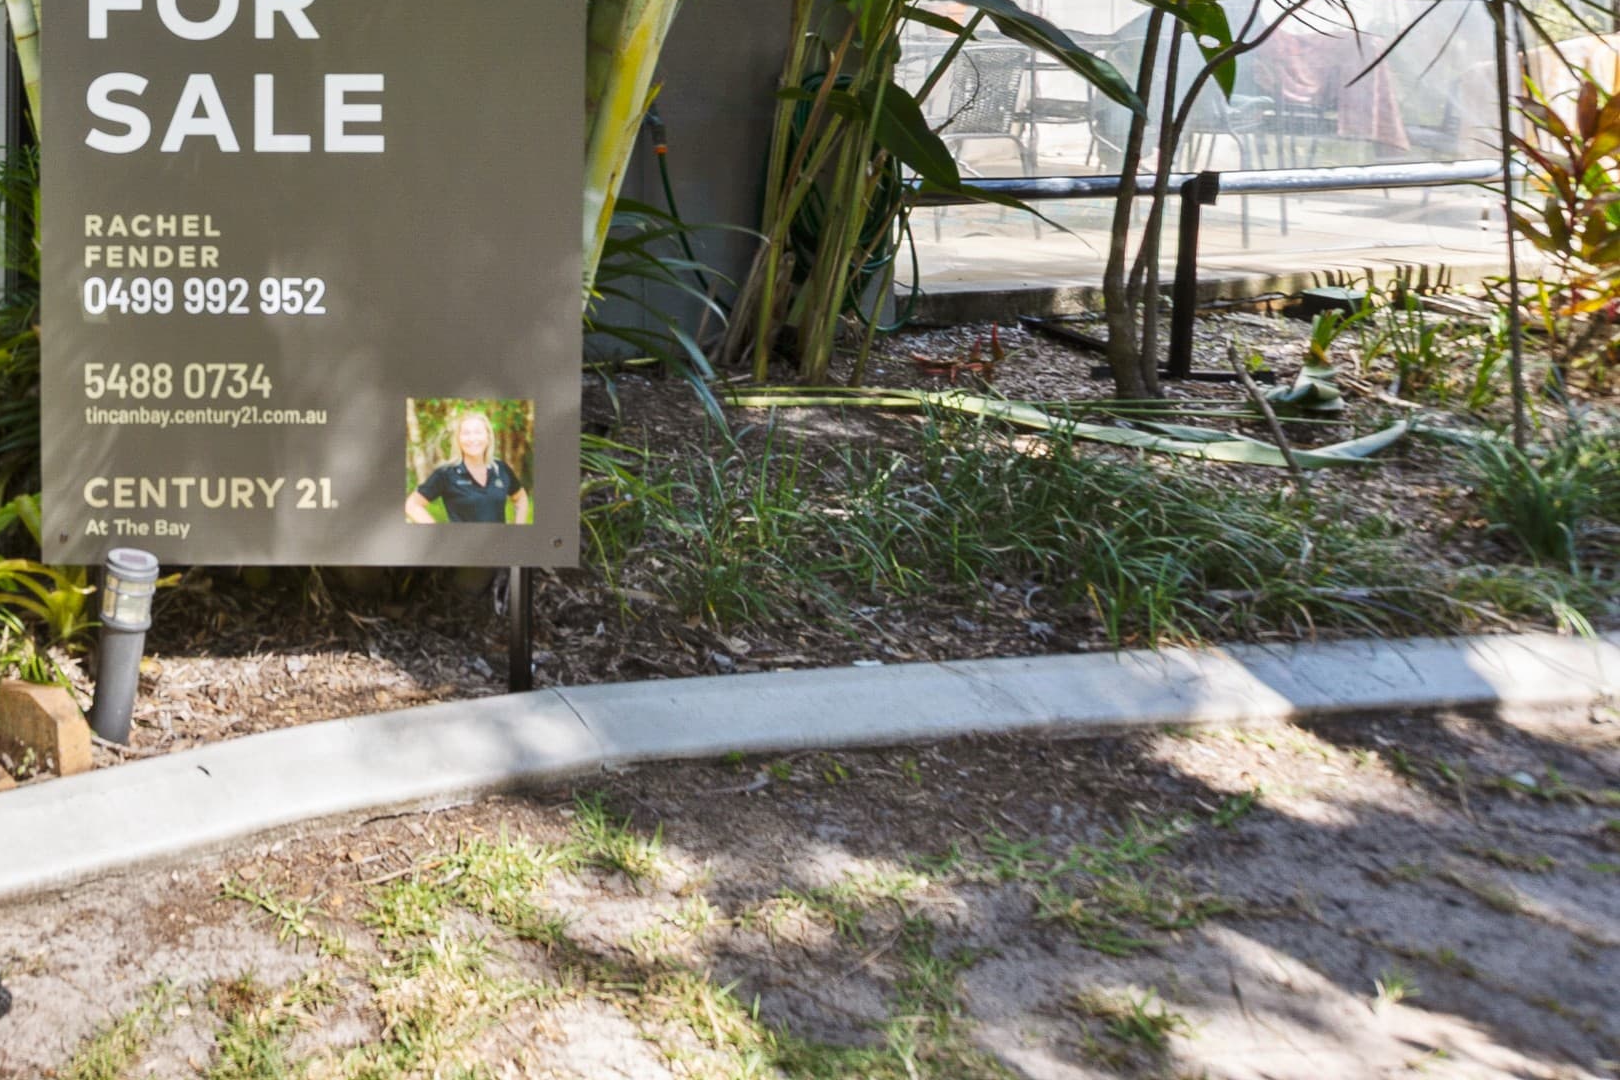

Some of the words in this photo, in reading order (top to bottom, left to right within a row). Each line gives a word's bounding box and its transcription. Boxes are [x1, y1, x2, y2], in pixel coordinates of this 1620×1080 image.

[84, 71, 385, 155] SALE
[84, 214, 222, 238] RACHEL
[84, 245, 220, 268] FENDER
[83, 276, 174, 315] 0499
[183, 276, 250, 315] 992
[259, 276, 326, 315] 952
[84, 362, 173, 400] 5488
[183, 362, 273, 400] 0734
[84, 405, 328, 428] tincanbay.century21.com.au
[83, 476, 285, 509] CENTURY
[84, 518, 109, 536] At
[113, 518, 150, 536] The
[154, 518, 191, 540] Bay
